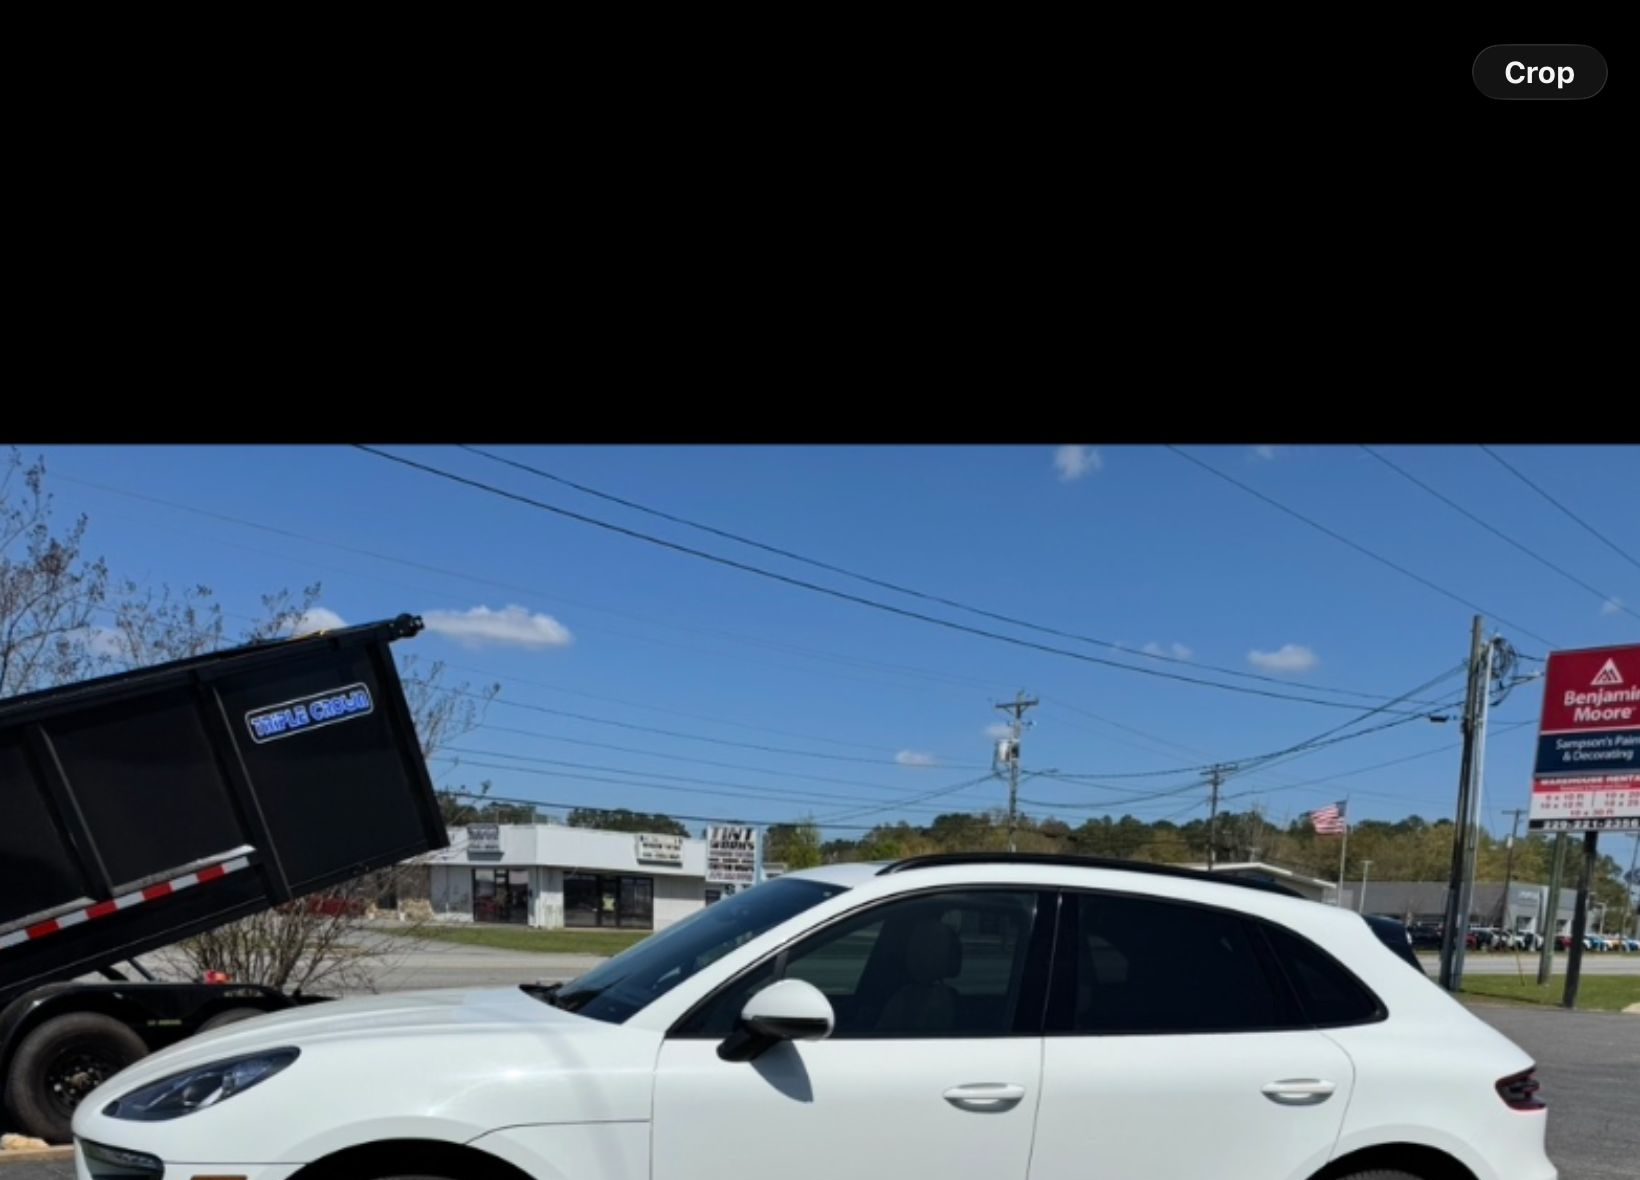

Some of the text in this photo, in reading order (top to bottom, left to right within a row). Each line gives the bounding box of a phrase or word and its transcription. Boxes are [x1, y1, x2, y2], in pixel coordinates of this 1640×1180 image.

[310, 689, 370, 721] CROWN
[1574, 706, 1632, 722] Moore
[1556, 736, 1613, 751] Sampson's
[1562, 749, 1634, 762] & Decorating
[711, 826, 755, 841] TINT
